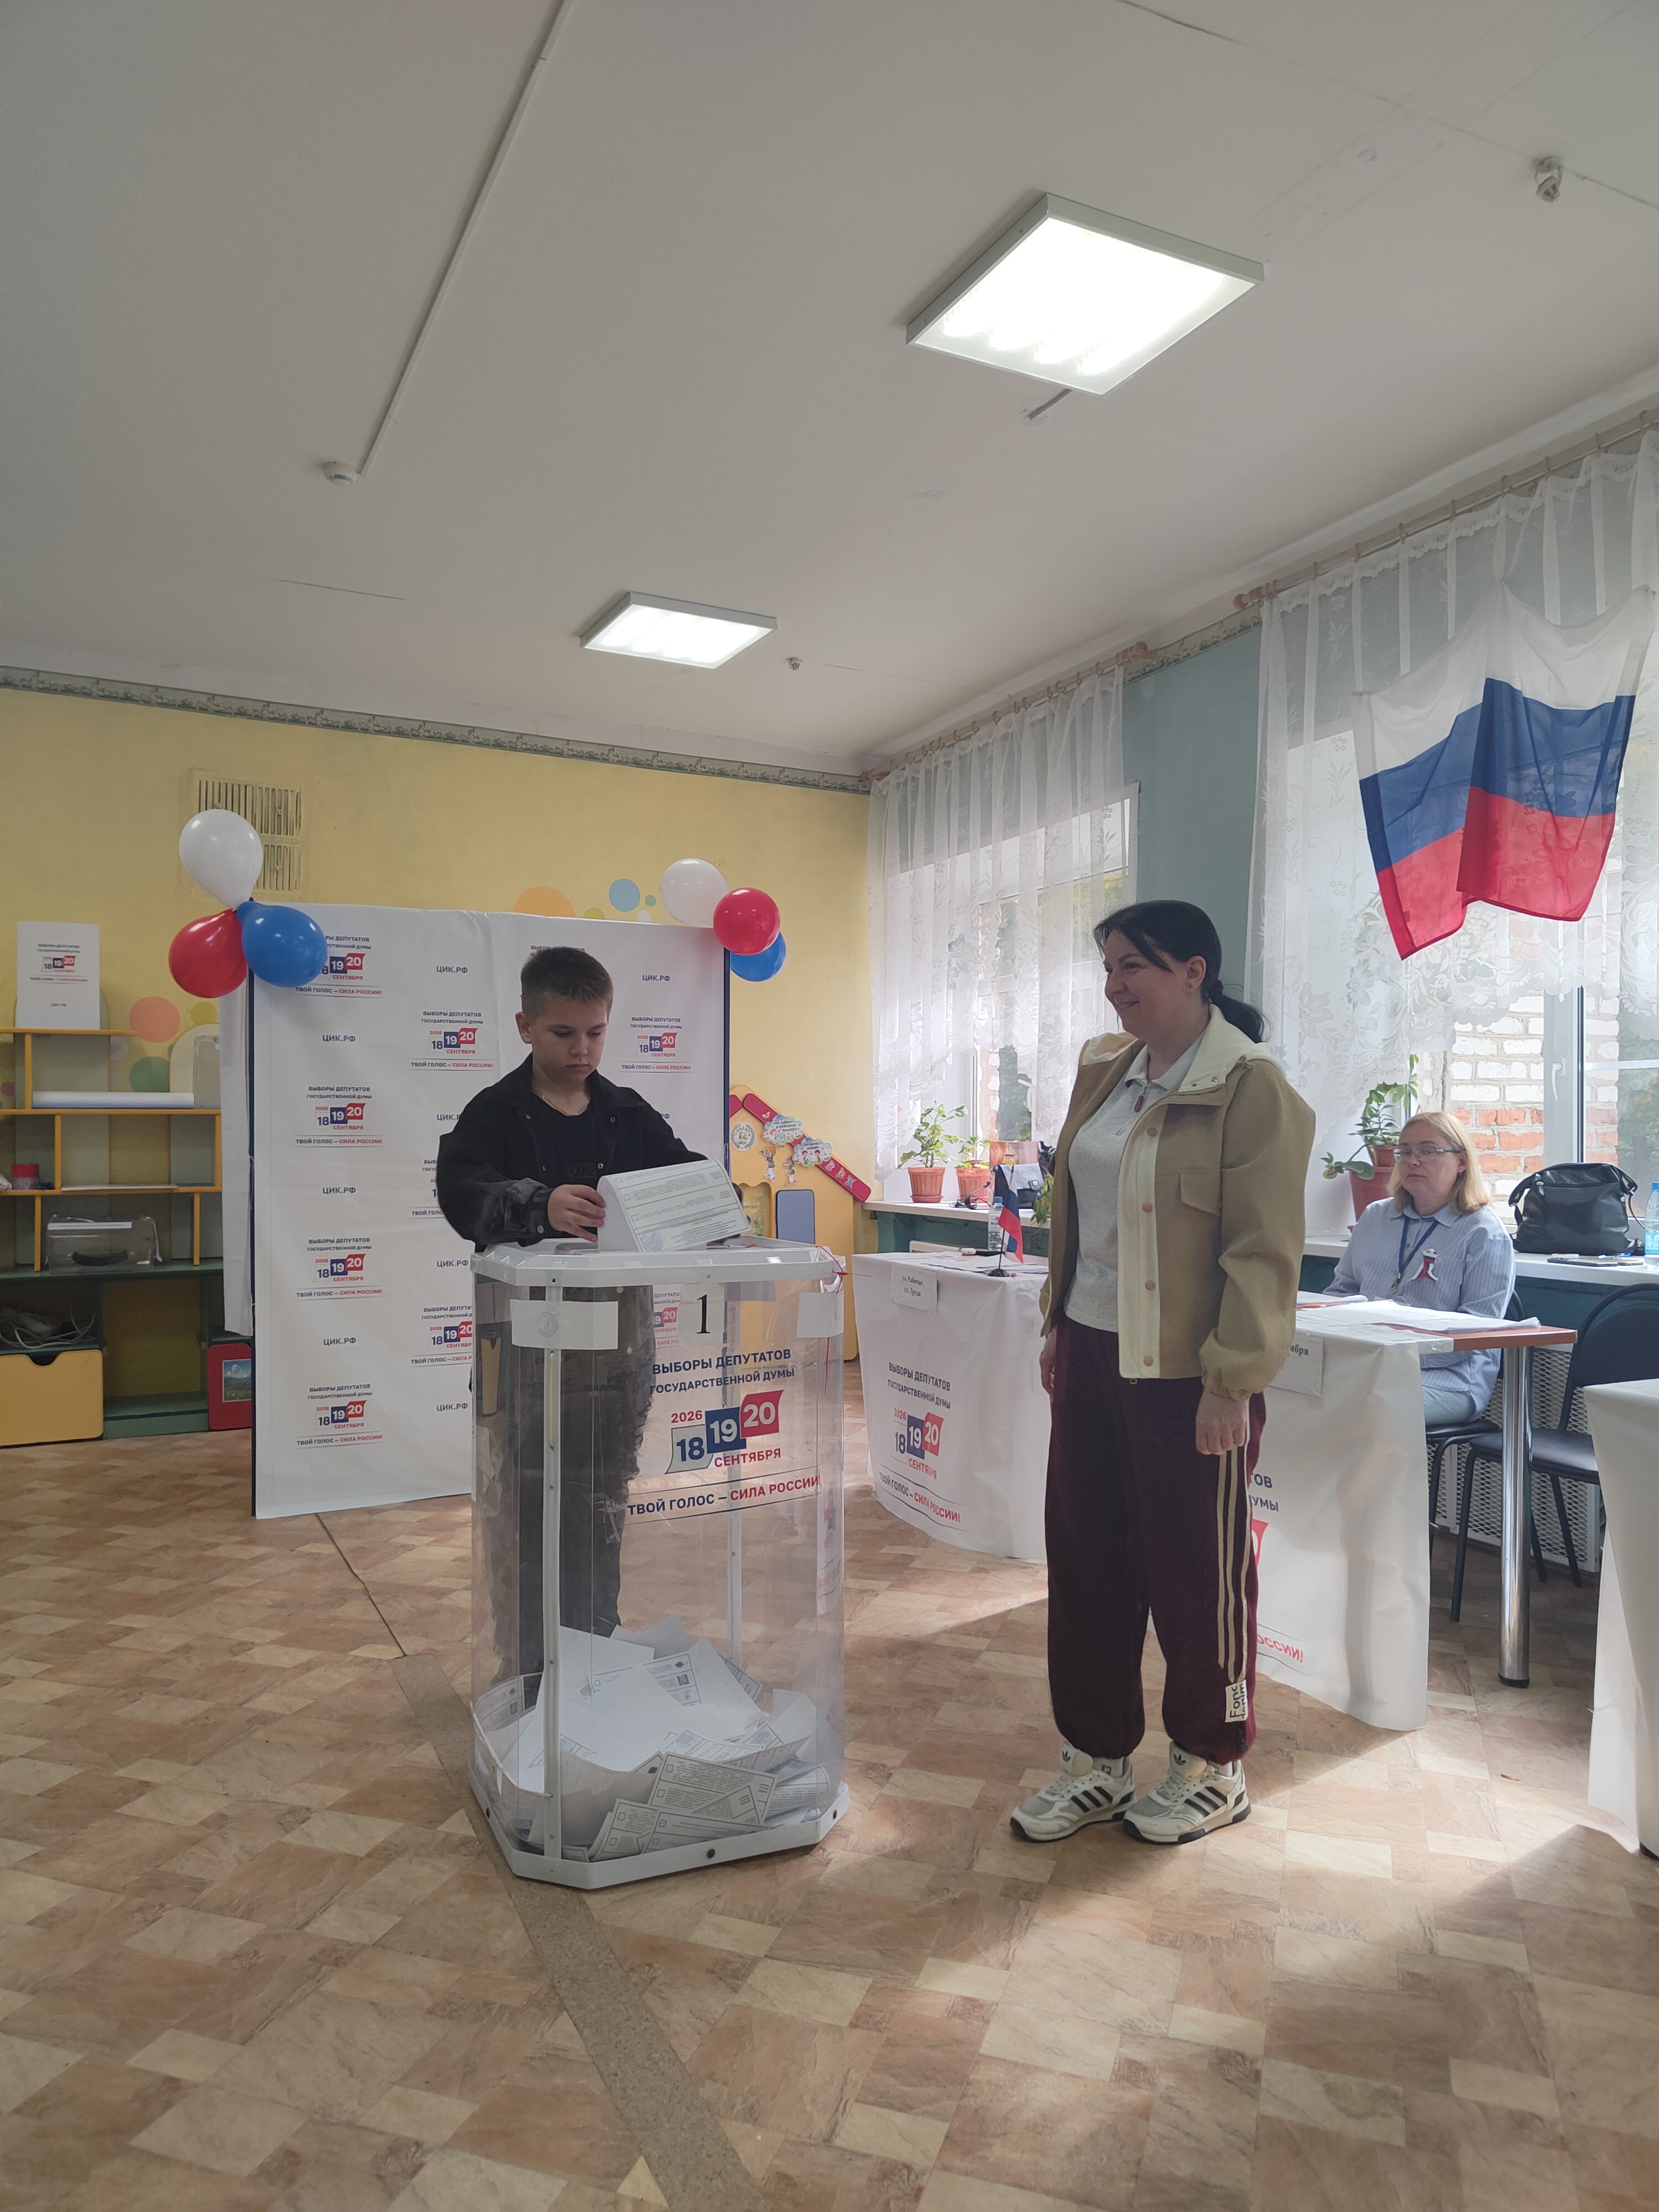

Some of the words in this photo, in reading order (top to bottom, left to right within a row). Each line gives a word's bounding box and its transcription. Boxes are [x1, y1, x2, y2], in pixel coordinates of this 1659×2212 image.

[320, 966, 328, 974] 8
[331, 961, 343, 970] 19
[346, 957, 361, 966] 20
[431, 1040, 443, 1050] 18
[445, 1035, 457, 1045] 19
[460, 1031, 474, 1041] 20
[639, 1044, 649, 1053] 18
[651, 1040, 660, 1048] 19
[662, 1036, 674, 1045] 20
[317, 1117, 329, 1126] 18
[332, 1111, 345, 1121] 19
[347, 1107, 362, 1117] 20
[317, 1269, 330, 1278] 18
[332, 1263, 345, 1273] 19
[347, 1258, 362, 1267] 20
[437, 1260, 468, 1268] ЦИК.РФ
[664, 1311, 676, 1319] 20
[696, 1294, 711, 1334] 1
[324, 1337, 357, 1345] ЦИК.РФ
[431, 1336, 443, 1345] 18
[445, 1330, 457, 1340] 19
[460, 1324, 472, 1334] 20
[653, 1358, 712, 1375] ВЫБОРЫ
[716, 1349, 791, 1369] ДЕПУТАТОВ
[649, 1370, 760, 1395] ГОСУДАРСТВЕННОЙ
[763, 1368, 795, 1381] ДУМЫ
[889, 1362, 913, 1379] ВЫБОРЫ
[914, 1370, 951, 1391] ДЕПУТАТОВ
[888, 1379, 935, 1404] ГОСУДАРСТВЕННОЙ
[935, 1396, 951, 1410] ДУМЫ
[318, 1416, 330, 1426] 18
[332, 1410, 345, 1420] 19
[348, 1405, 363, 1415] 20
[436, 1403, 468, 1412] ЦИК.РФ
[671, 1410, 703, 1423] 2026
[894, 1407, 907, 1421] 2026
[676, 1437, 705, 1462] 18
[709, 1418, 738, 1444] 19
[743, 1401, 775, 1428] 20
[895, 1431, 906, 1454] 18
[909, 1426, 922, 1449] 19
[925, 1421, 939, 1446] 20
[714, 1448, 781, 1468] СЕНТЯБРЯ
[908, 1458, 937, 1480] СЕНТЯБРЯ
[627, 1498, 666, 1516] ТВОЙ
[669, 1494, 715, 1510] ГОЛОС
[730, 1486, 766, 1500] СИЛА
[769, 1474, 821, 1495] РОССИИ!
[879, 1471, 891, 1488] ТВОЙ
[891, 1479, 909, 1497] ГОЛОС
[914, 1492, 930, 1508] СИЛА
[930, 1501, 961, 1523] РОССИИ!
[1252, 1495, 1279, 1512] УМЫ
